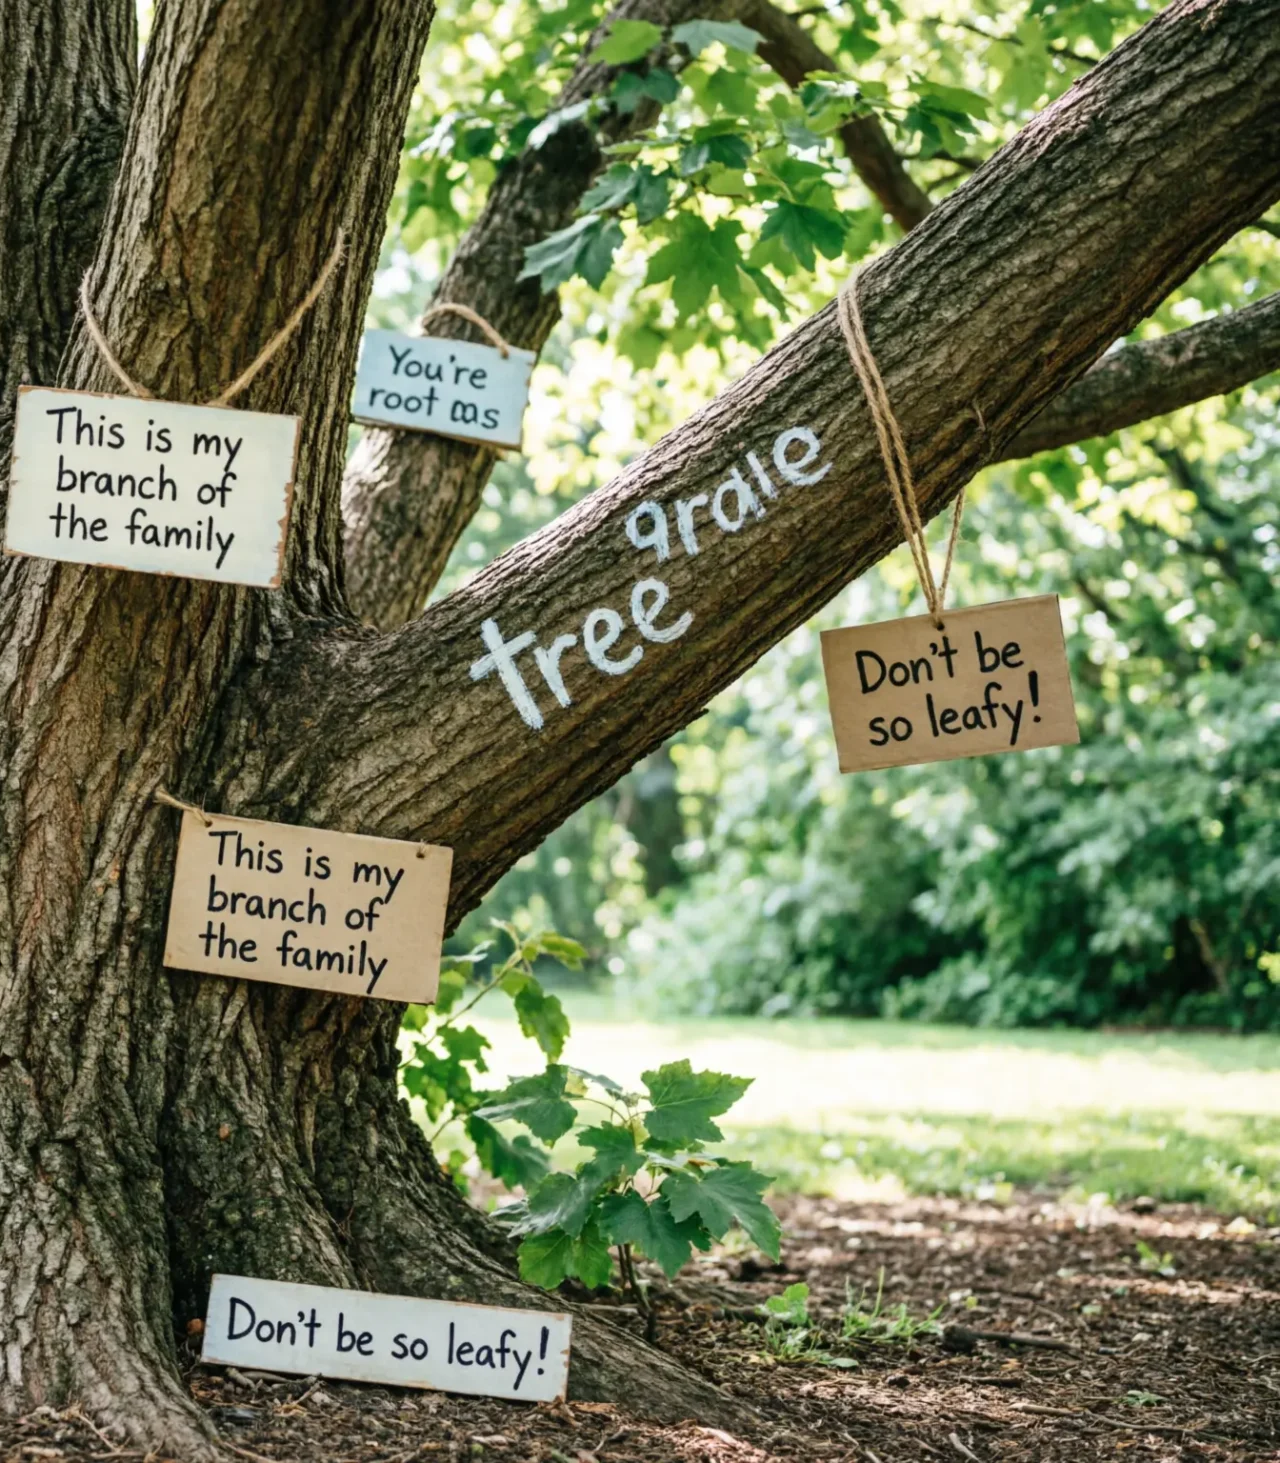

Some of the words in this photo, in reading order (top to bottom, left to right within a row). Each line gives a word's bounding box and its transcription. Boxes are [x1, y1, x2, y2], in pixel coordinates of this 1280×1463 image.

[390, 346, 486, 389] You're
[369, 387, 438, 415] root
[46, 407, 124, 449] This
[147, 420, 172, 453] is
[193, 432, 242, 473] my
[57, 455, 176, 501] branch
[197, 472, 237, 508] of
[50, 503, 108, 541] the
[125, 508, 234, 569] family
[470, 577, 692, 728] tree
[855, 636, 957, 694] Don't
[975, 631, 1024, 672] be
[869, 717, 912, 746] so
[926, 670, 1041, 746] leafy!
[209, 831, 283, 873] This
[305, 848, 331, 879] is
[353, 860, 405, 904] my
[208, 874, 326, 925] branch
[346, 897, 386, 932] of
[199, 921, 257, 962] the
[276, 930, 388, 994] family
[228, 1297, 321, 1347] Don't
[337, 1313, 373, 1356] be
[392, 1334, 428, 1360] so
[448, 1322, 549, 1390] leafy!
